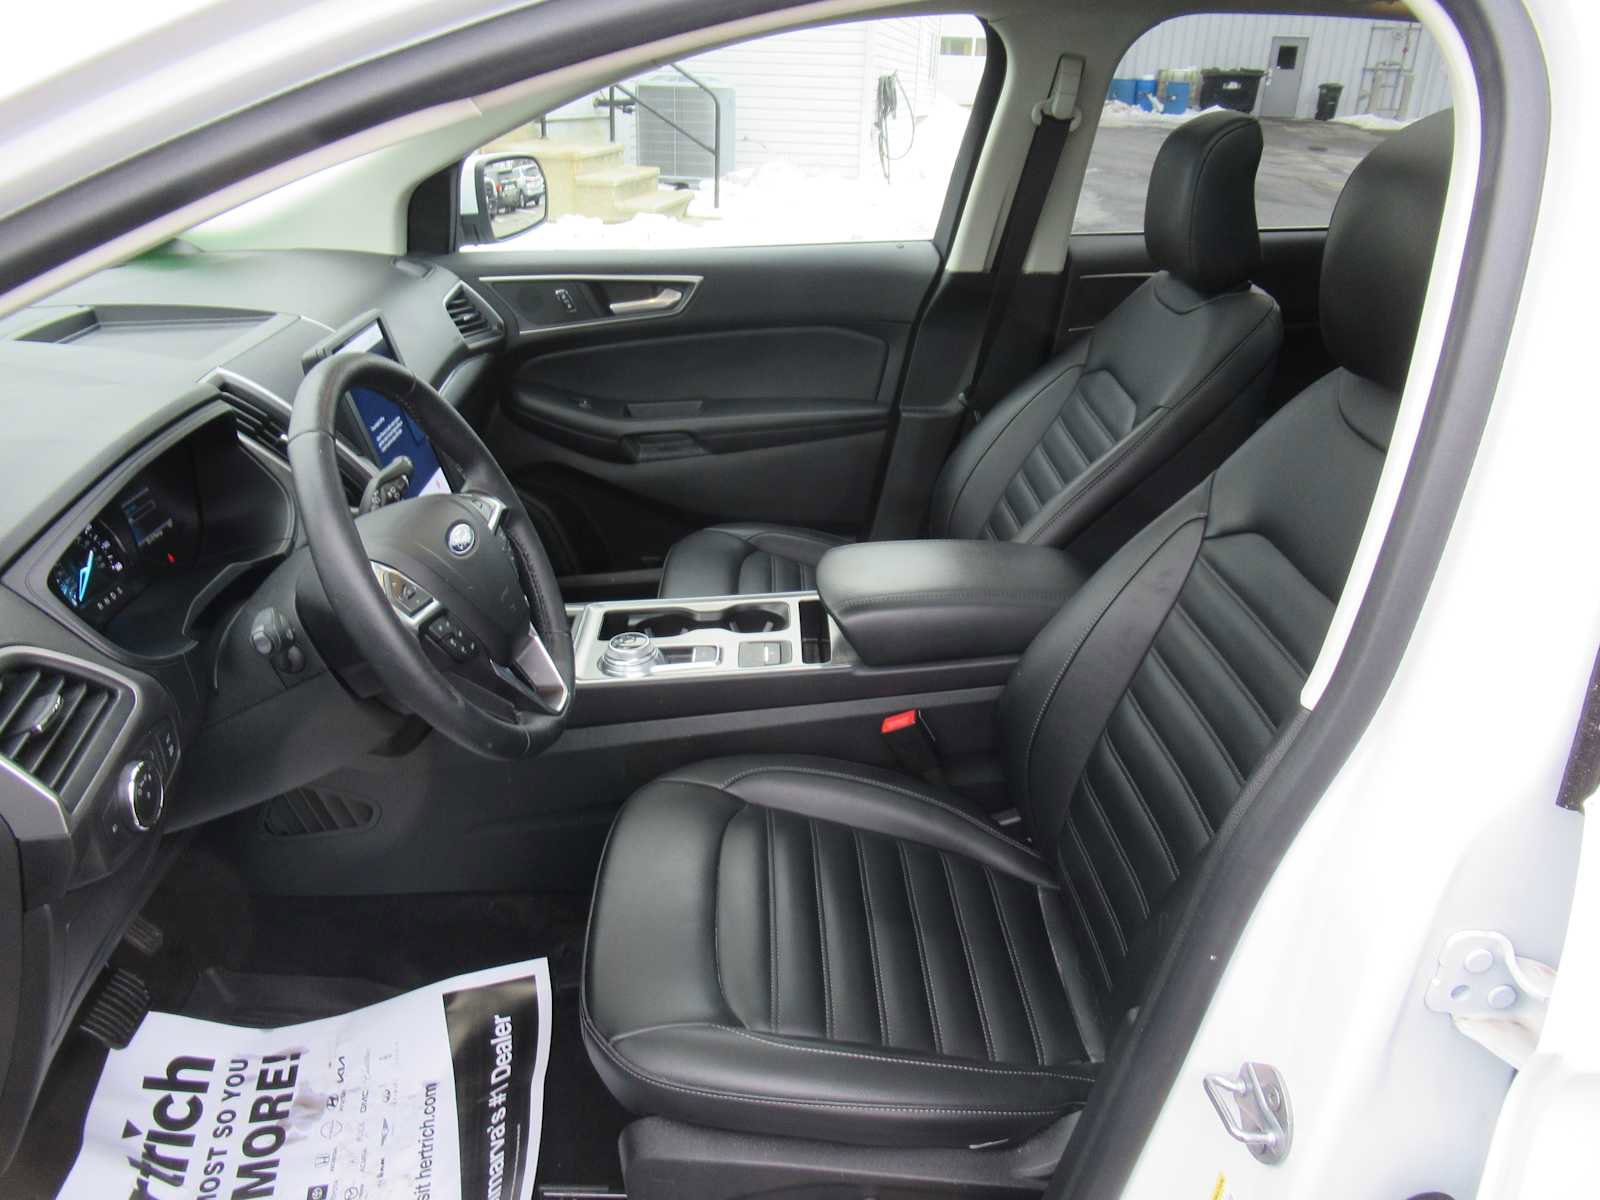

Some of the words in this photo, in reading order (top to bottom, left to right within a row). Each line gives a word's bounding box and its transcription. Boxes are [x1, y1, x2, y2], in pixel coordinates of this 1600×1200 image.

[490, 1014, 513, 1085] Dealer
[222, 1058, 249, 1103] YOU
[488, 1082, 509, 1108] #1
[211, 1109, 237, 1139] SO
[230, 1053, 301, 1200] MORE!
[415, 1082, 438, 1180] hertrich.com
